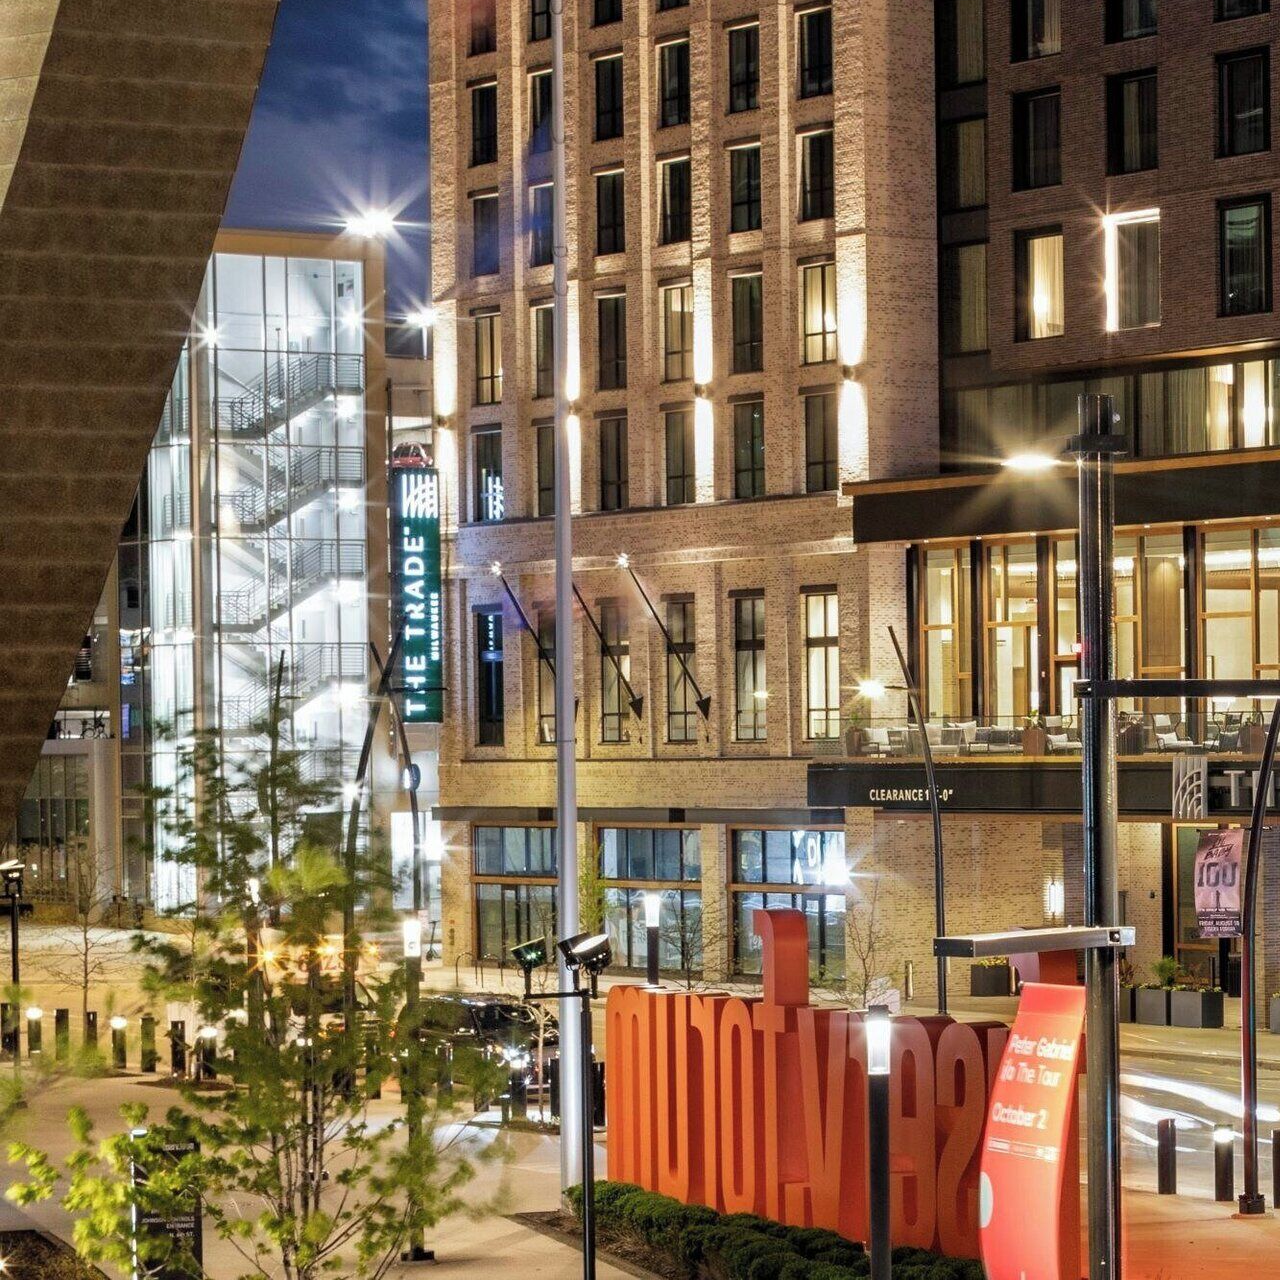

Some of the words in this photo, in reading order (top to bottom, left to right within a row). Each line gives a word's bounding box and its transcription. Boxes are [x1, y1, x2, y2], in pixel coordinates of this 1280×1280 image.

[403, 536, 425, 641] TRADE
[405, 654, 427, 716] THE
[869, 788, 924, 801] CLEARANCE
[992, 1102, 1037, 1128] October
[1037, 1108, 1049, 1130] 2
